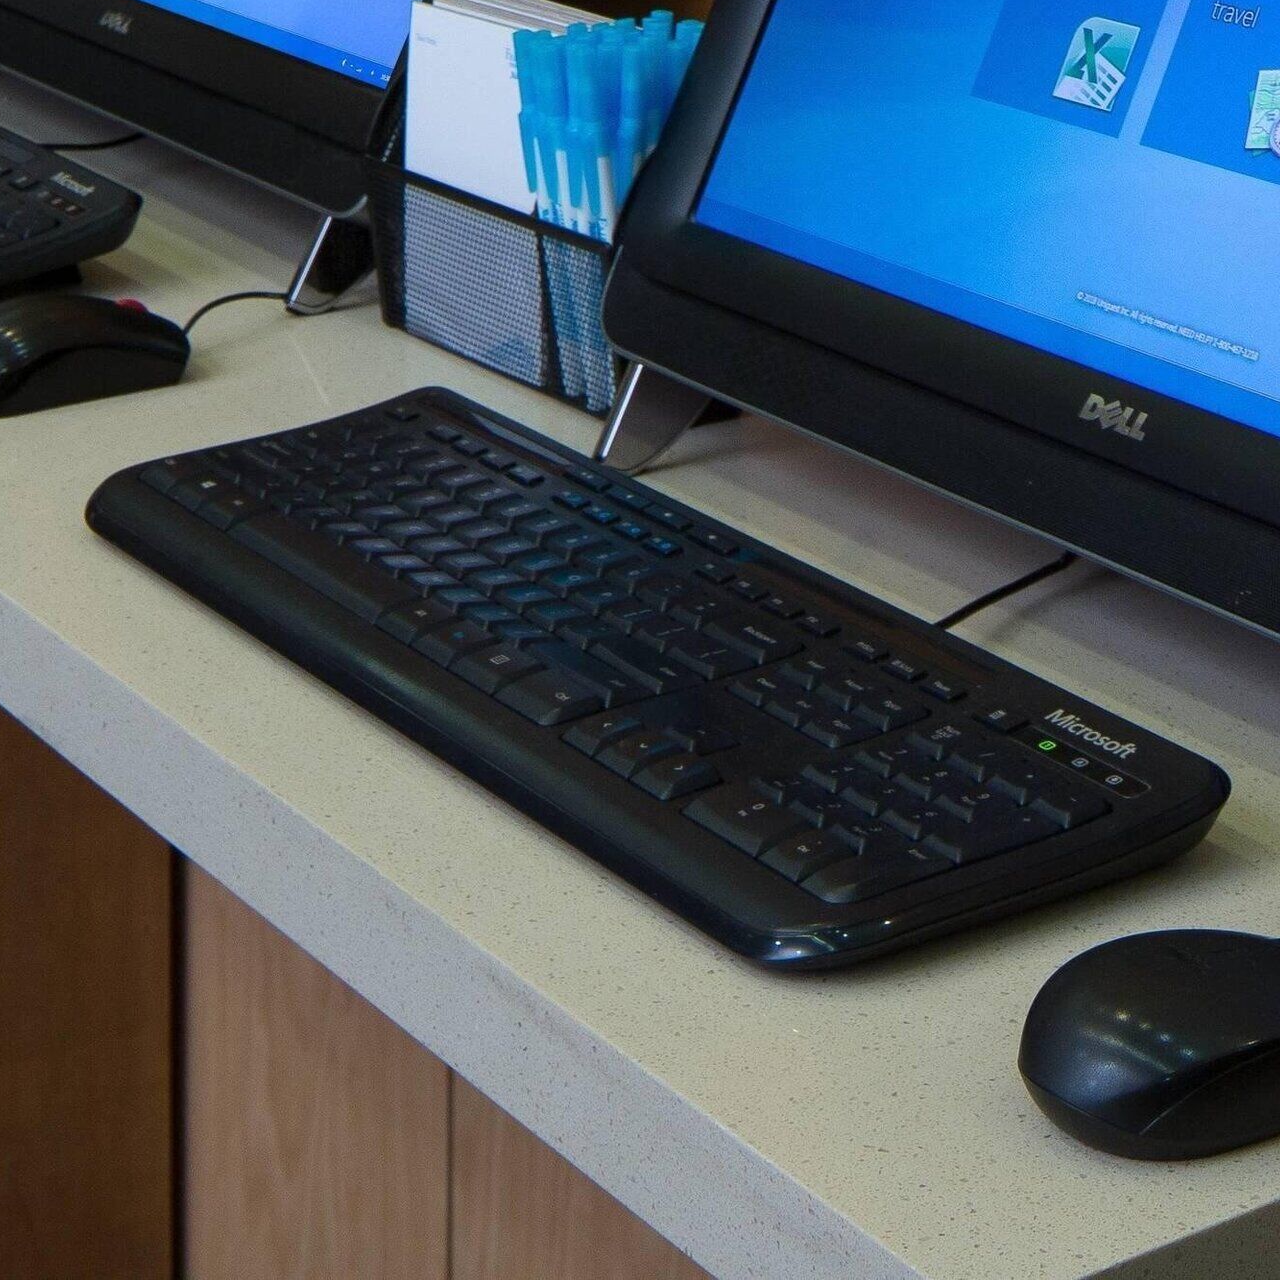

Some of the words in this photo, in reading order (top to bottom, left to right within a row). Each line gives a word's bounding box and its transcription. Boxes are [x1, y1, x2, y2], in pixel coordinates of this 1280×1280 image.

[1211, 0, 1261, 29] travel
[1079, 392, 1149, 441] DELL
[1044, 708, 1139, 760] Microsoft
